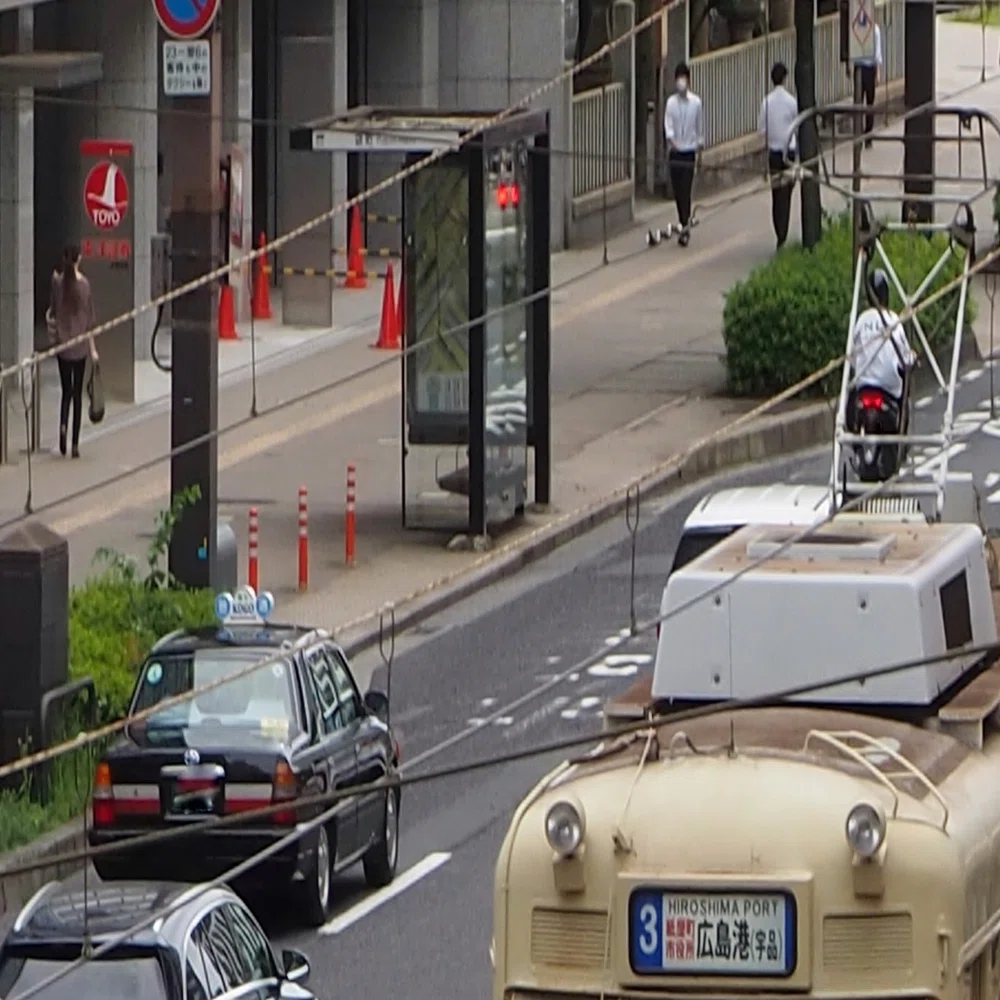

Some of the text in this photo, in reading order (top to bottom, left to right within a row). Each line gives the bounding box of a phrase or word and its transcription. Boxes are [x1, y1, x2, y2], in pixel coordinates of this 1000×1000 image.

[92, 208, 121, 228] TOYO
[668, 899, 779, 917] HIROSHIMA PORT
[639, 904, 658, 954] 3
